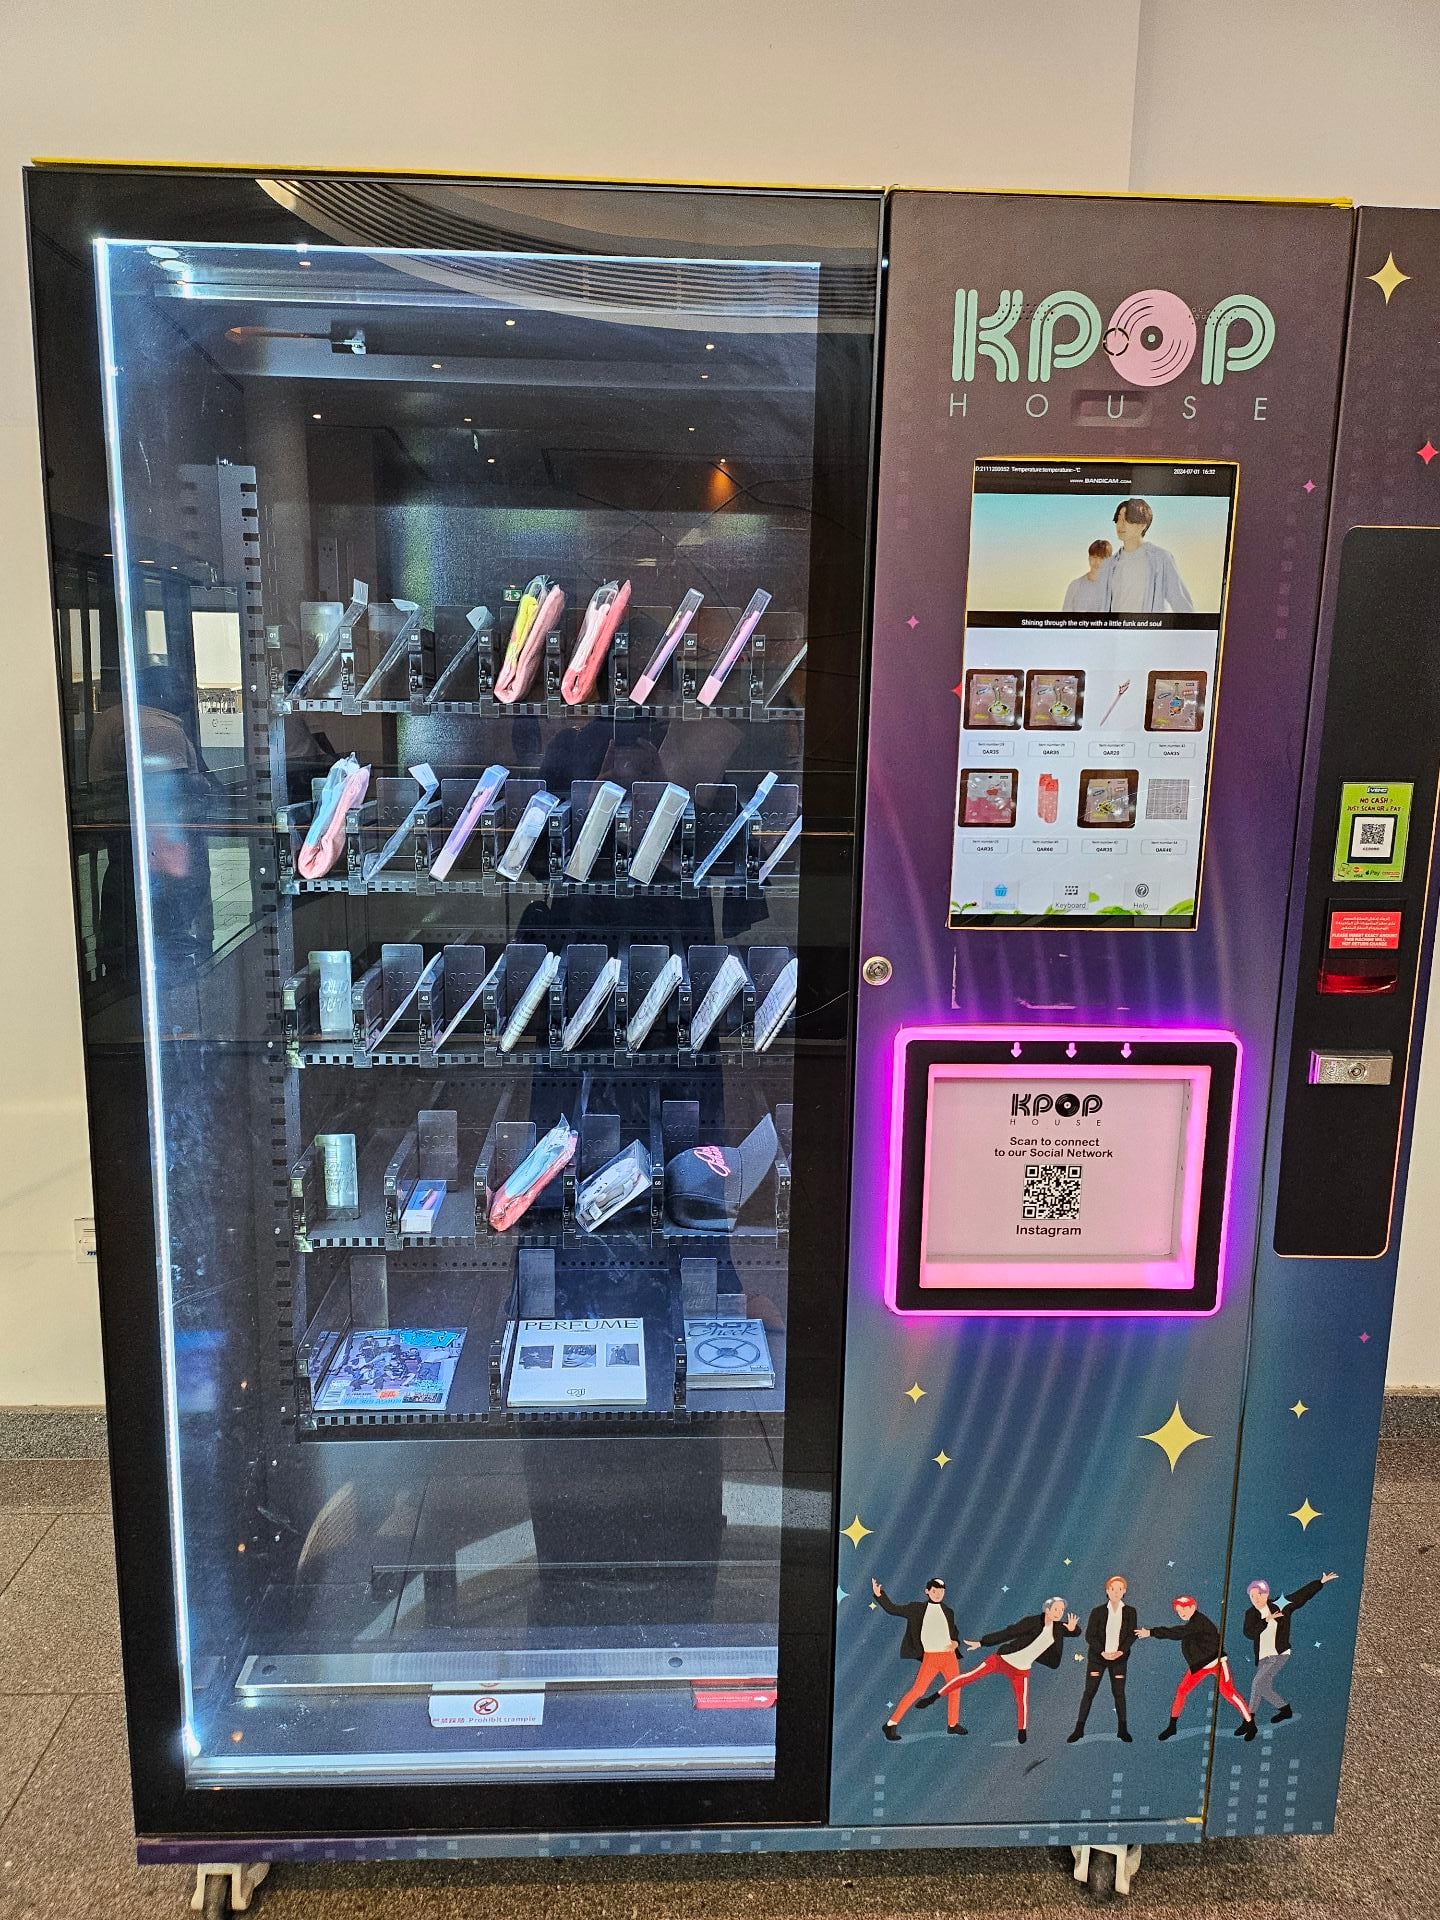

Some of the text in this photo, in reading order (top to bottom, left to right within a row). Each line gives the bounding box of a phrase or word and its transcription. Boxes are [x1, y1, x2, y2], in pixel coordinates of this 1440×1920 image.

[952, 288, 1276, 387] KPOP
[949, 393, 1268, 420] HOUSE
[1021, 619, 1044, 627] Shining
[1044, 619, 1067, 627] through
[1370, 796, 1388, 804] CASH
[1055, 902, 1086, 910] Keyboard
[1133, 902, 1149, 910] Help
[1010, 1093, 1103, 1117] KPOP
[1009, 1136, 1100, 1147] Scan to connect
[994, 1148, 1006, 1157] to
[1029, 1148, 1064, 1158] Social
[1066, 1148, 1113, 1158] Network
[1016, 1224, 1082, 1238] Instagram
[525, 1319, 638, 1330] PERFUME
[688, 1326, 759, 1336] Check
